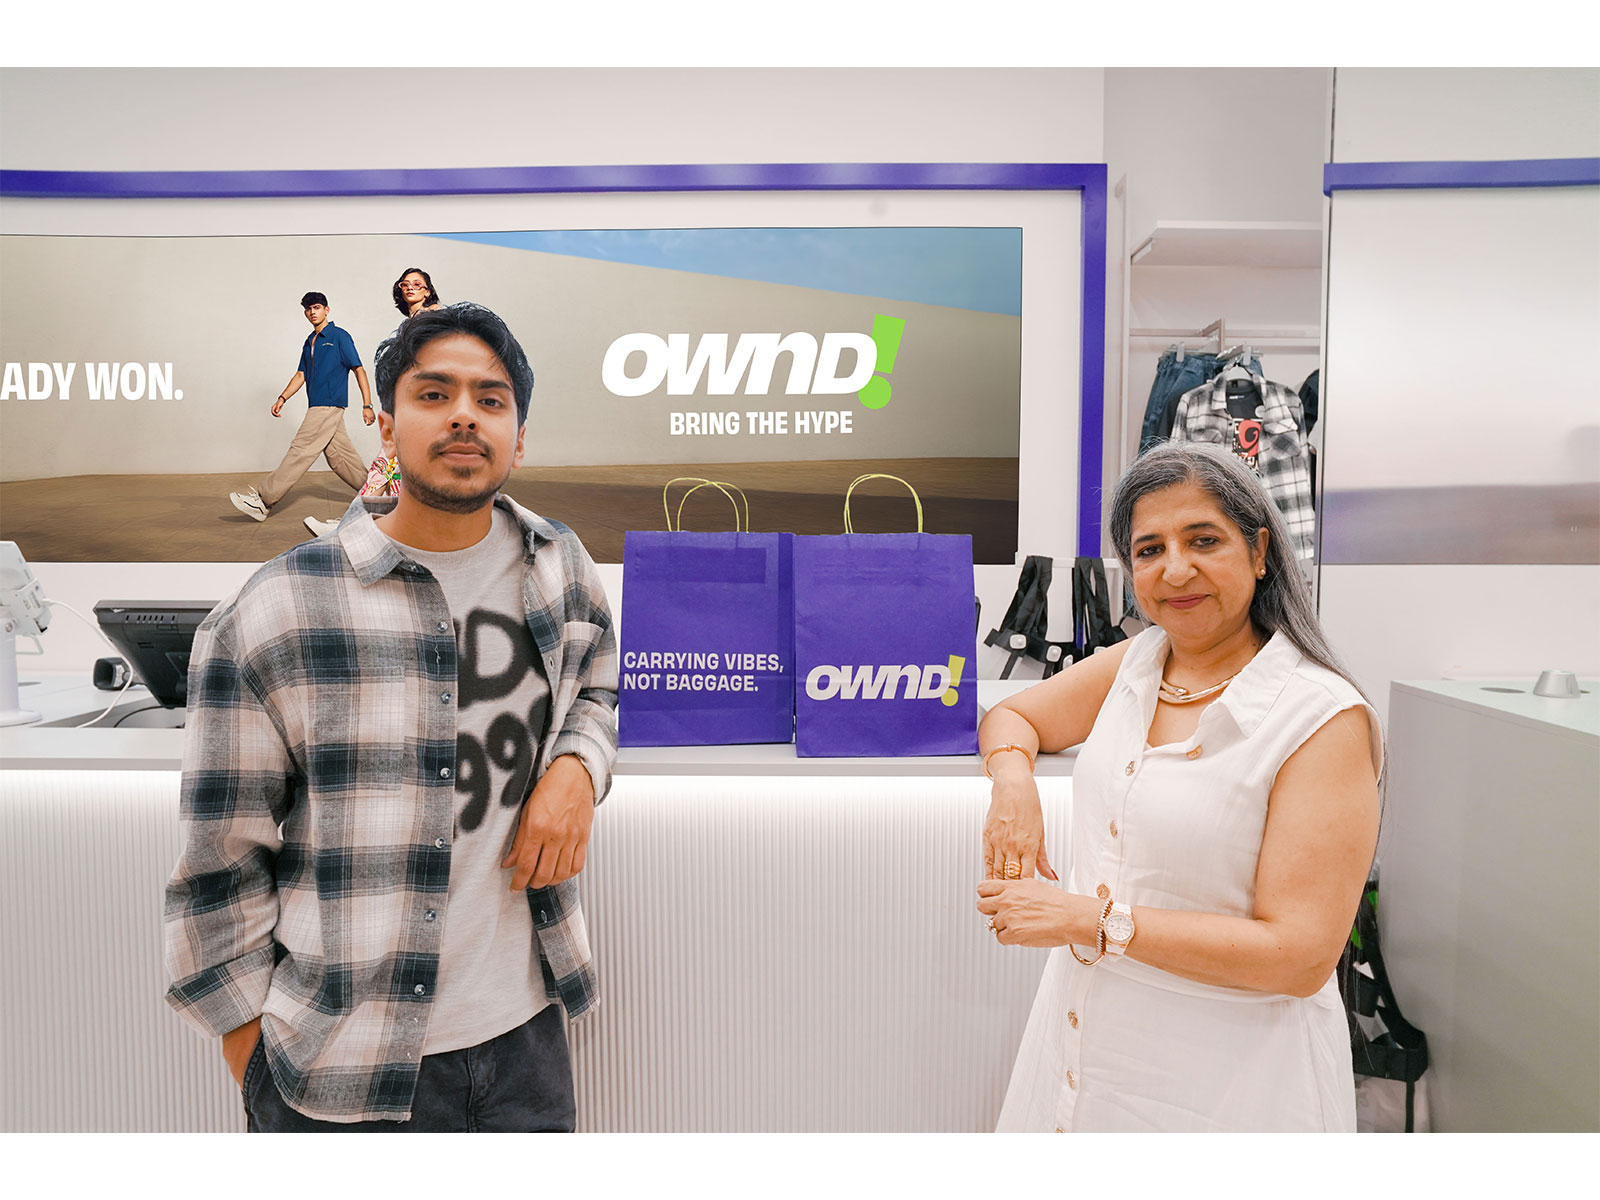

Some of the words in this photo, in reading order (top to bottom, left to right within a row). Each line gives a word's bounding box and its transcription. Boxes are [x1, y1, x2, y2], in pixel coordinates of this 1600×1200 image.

[84, 361, 184, 401] WON.
[669, 411, 741, 436] BRING
[746, 411, 788, 435] THE
[794, 410, 853, 435] HYPE
[623, 651, 719, 671] CARRYING
[724, 653, 784, 673] VIBES,
[623, 673, 661, 691] NOT
[666, 674, 759, 692] BAGGAGE.
